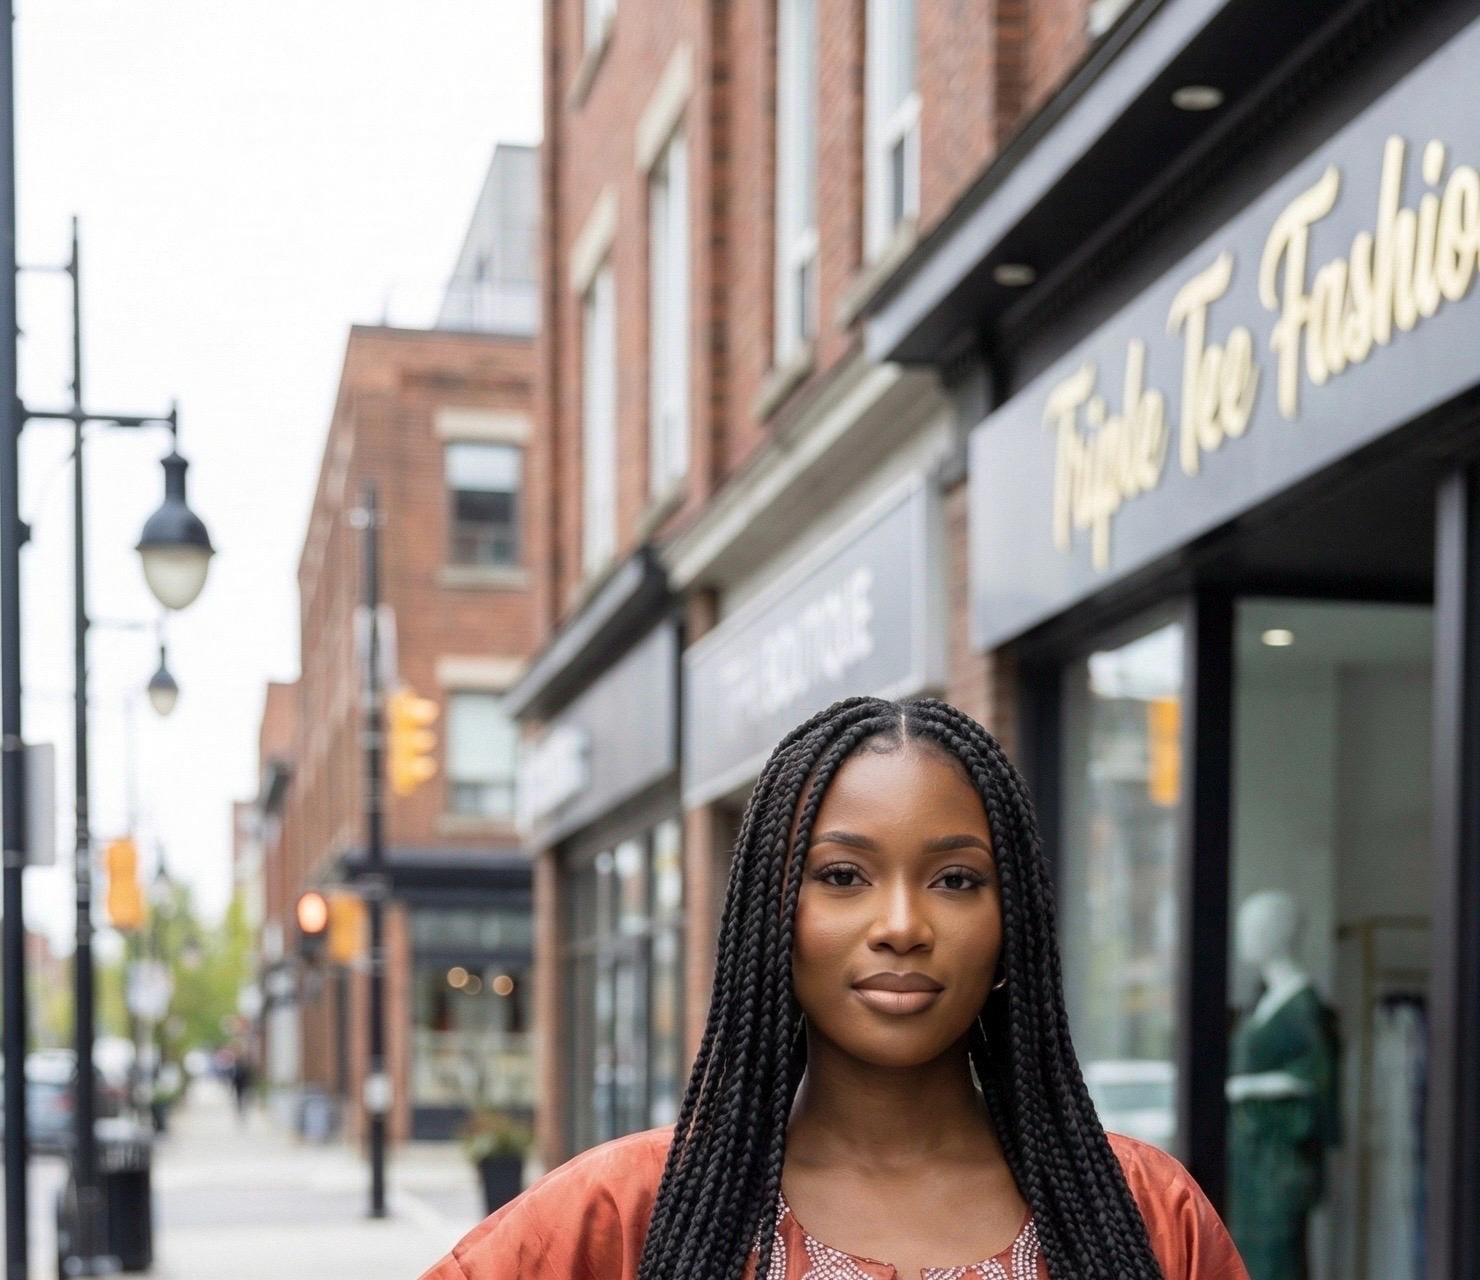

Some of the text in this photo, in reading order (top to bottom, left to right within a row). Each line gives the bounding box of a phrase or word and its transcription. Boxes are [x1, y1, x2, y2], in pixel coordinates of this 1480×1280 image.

[1045, 135, 1480, 570] Triple Tee Fashio
